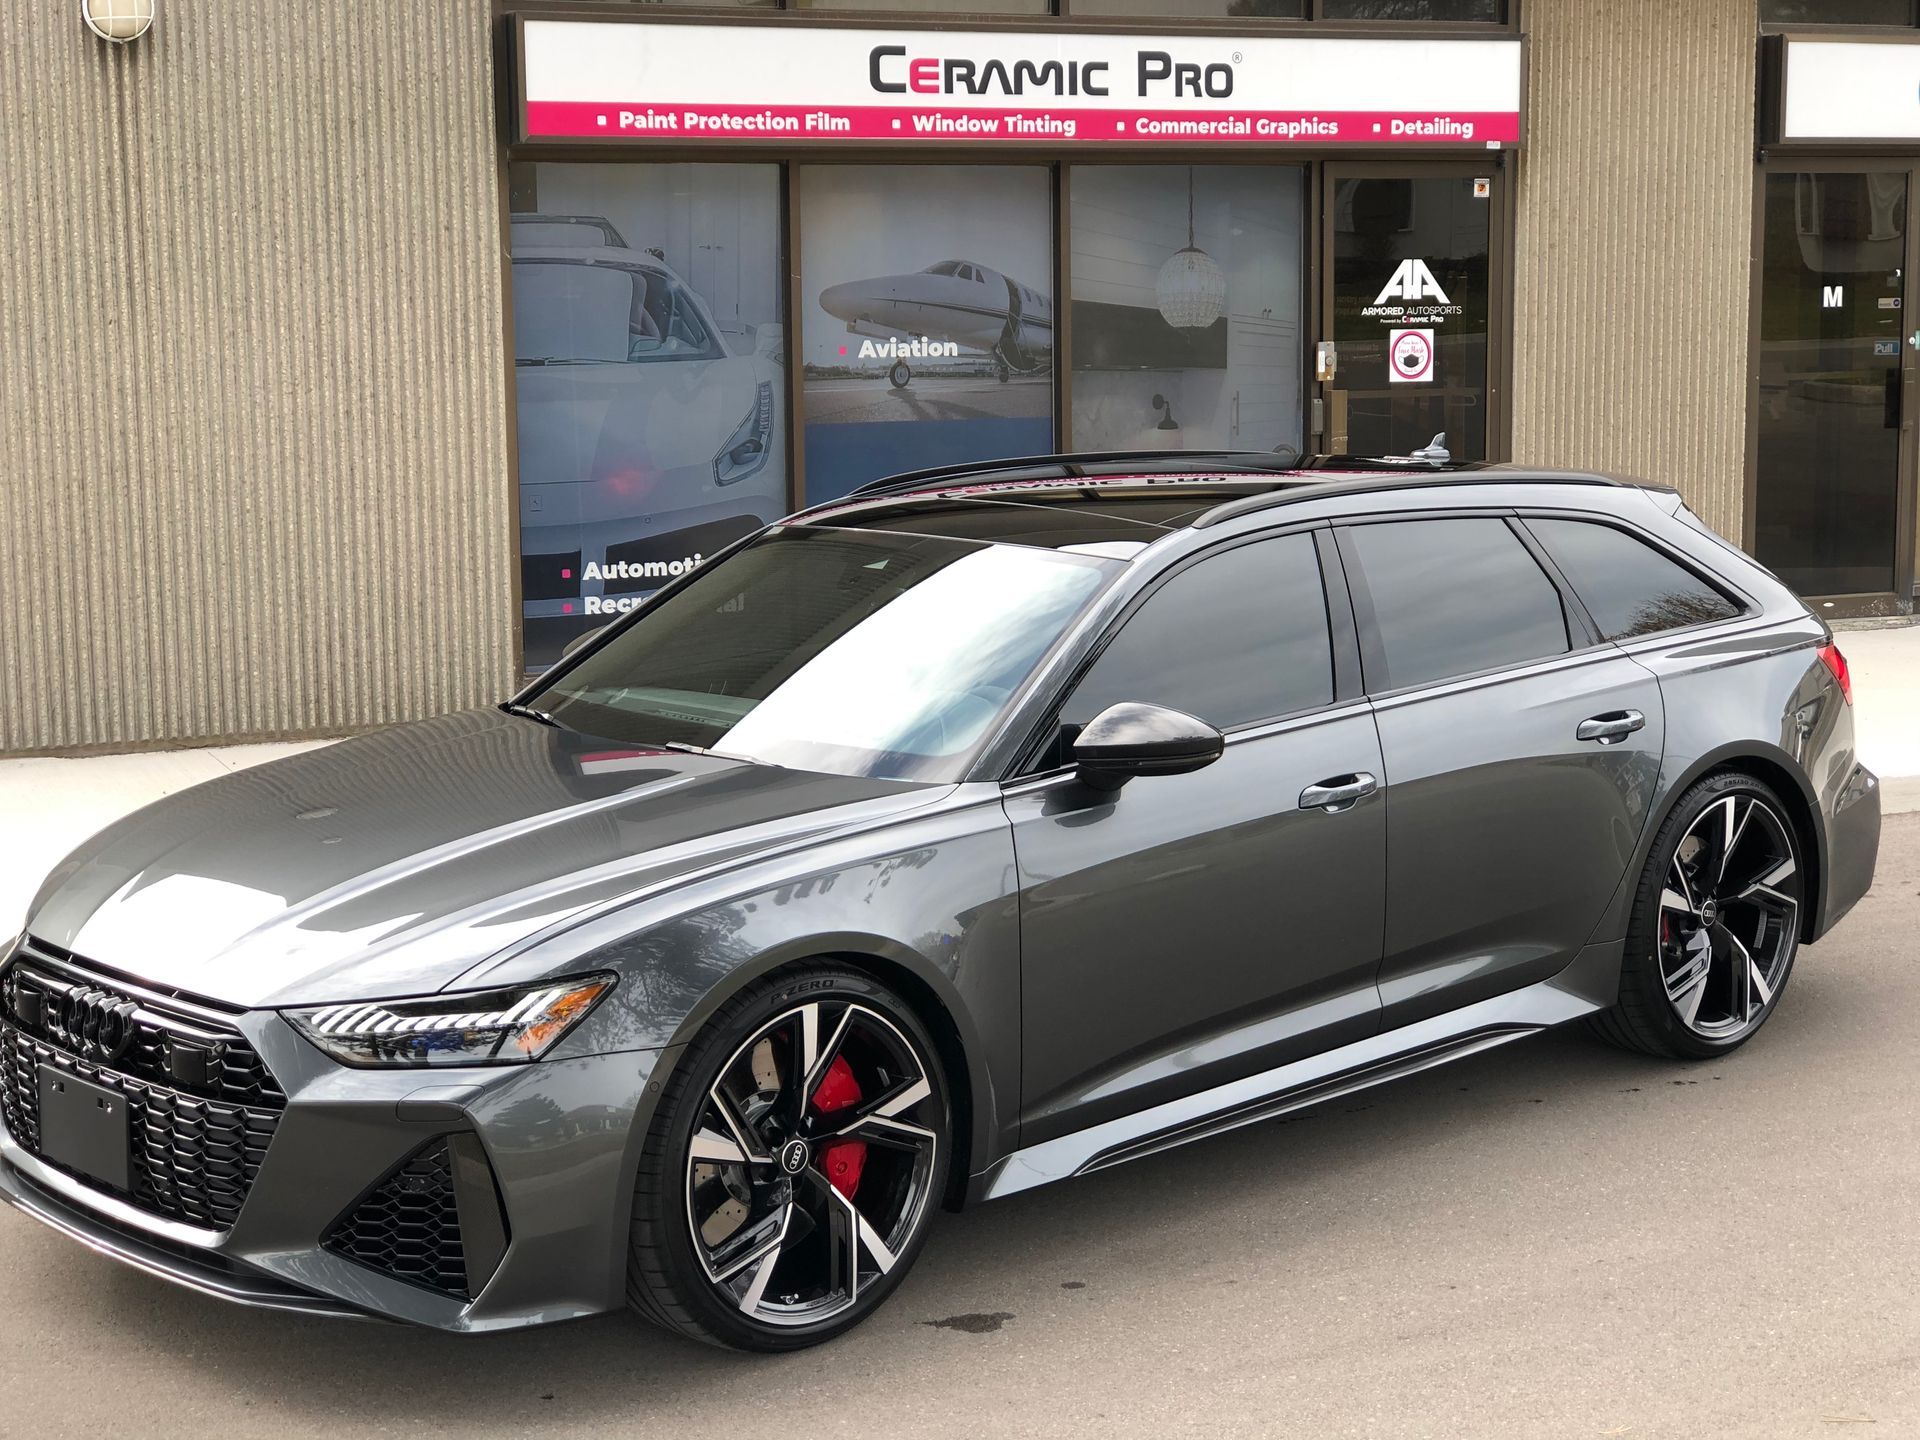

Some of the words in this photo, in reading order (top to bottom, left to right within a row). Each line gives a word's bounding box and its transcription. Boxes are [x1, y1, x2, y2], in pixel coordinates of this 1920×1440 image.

[869, 45, 1109, 97] CERAMIC
[619, 109, 677, 129] Paint
[684, 111, 799, 131] Protection
[805, 112, 851, 131] Film
[912, 113, 999, 133] Window
[1004, 114, 1077, 137] Tinting
[1135, 116, 1251, 135] Commercial
[1256, 117, 1339, 139] Graphics
[1390, 118, 1474, 139] Detailing
[1822, 285, 1843, 308] M
[1361, 306, 1405, 316] ARMORED
[1406, 305, 1463, 315] AUTOSPORTS
[858, 336, 958, 358] Aviation
[1875, 343, 1893, 353] Pull
[583, 553, 705, 581] Automoti
[787, 980, 834, 995] ZERO
